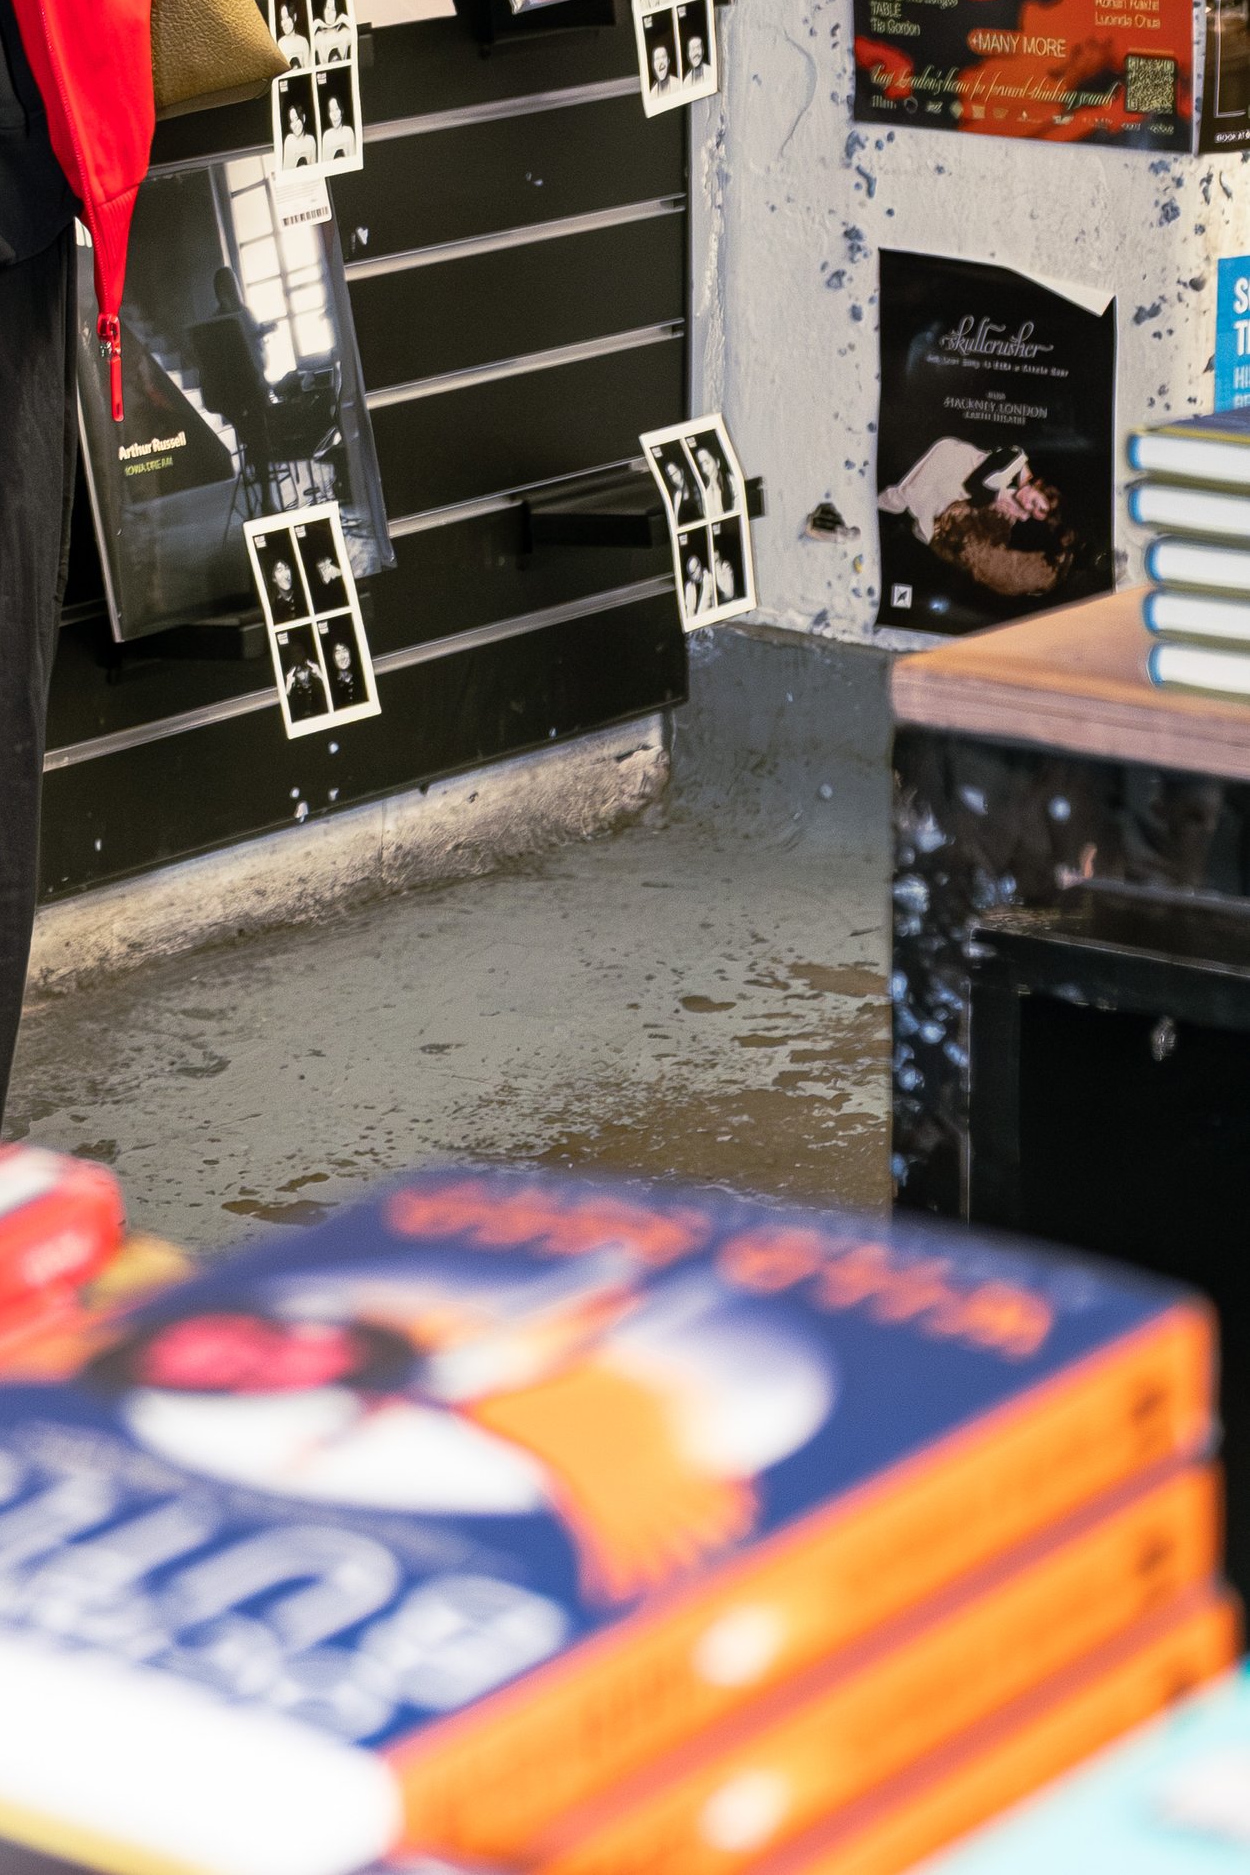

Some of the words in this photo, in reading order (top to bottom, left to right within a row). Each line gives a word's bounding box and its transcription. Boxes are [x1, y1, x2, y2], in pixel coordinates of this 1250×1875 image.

[869, 0, 902, 18] TABLE
[869, 16, 887, 34] Tia
[887, 19, 921, 37] Gordon
[971, 34, 1020, 54] +MANY
[1023, 36, 1067, 58] MORE
[999, 402, 1048, 419] LONDON
[118, 442, 152, 461] Arthur
[151, 430, 187, 453] Russell
